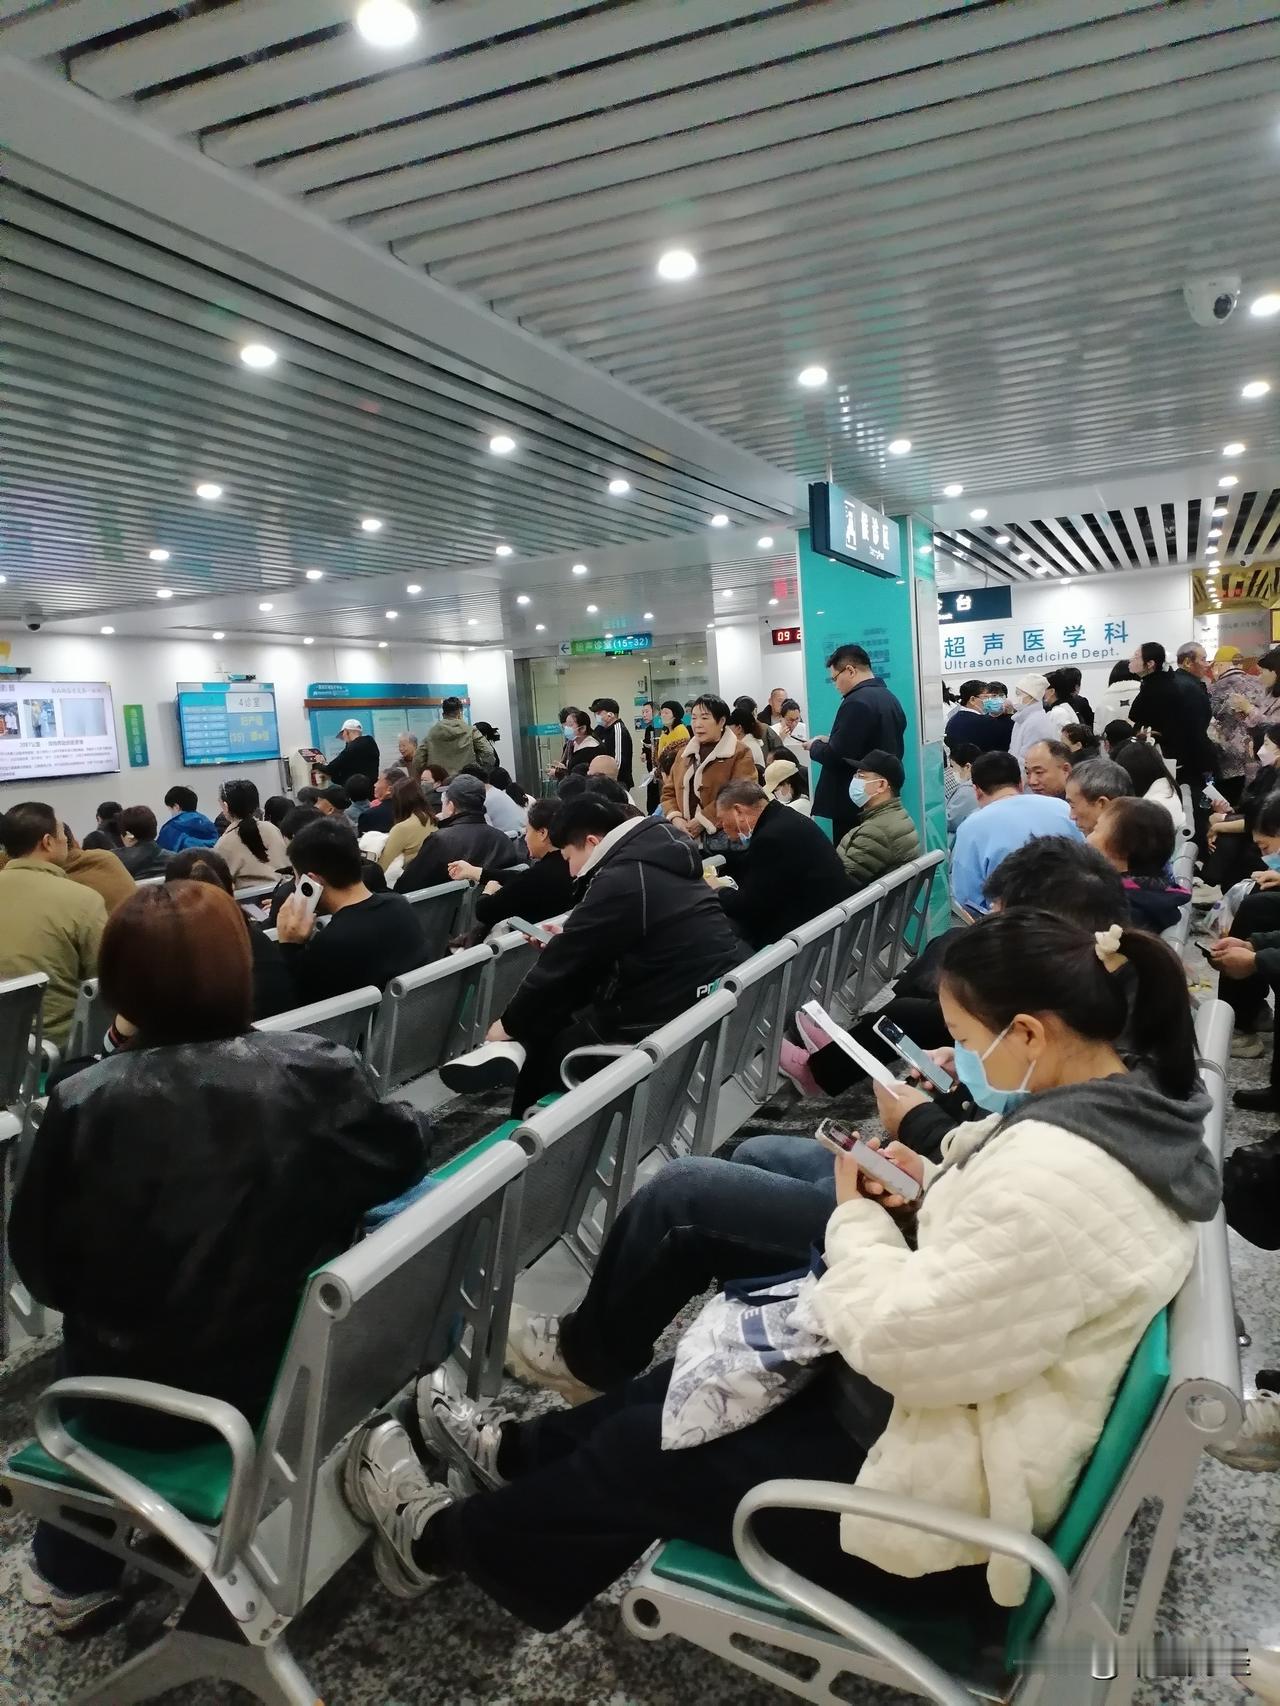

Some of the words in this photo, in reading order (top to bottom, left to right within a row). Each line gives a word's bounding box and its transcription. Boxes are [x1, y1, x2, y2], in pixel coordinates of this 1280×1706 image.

[944, 620, 1129, 659] 超声医学科
[944, 656, 1012, 670] Ultrasonic
[1016, 651, 1078, 664] Medicine
[1081, 647, 1120, 659] Dept.
